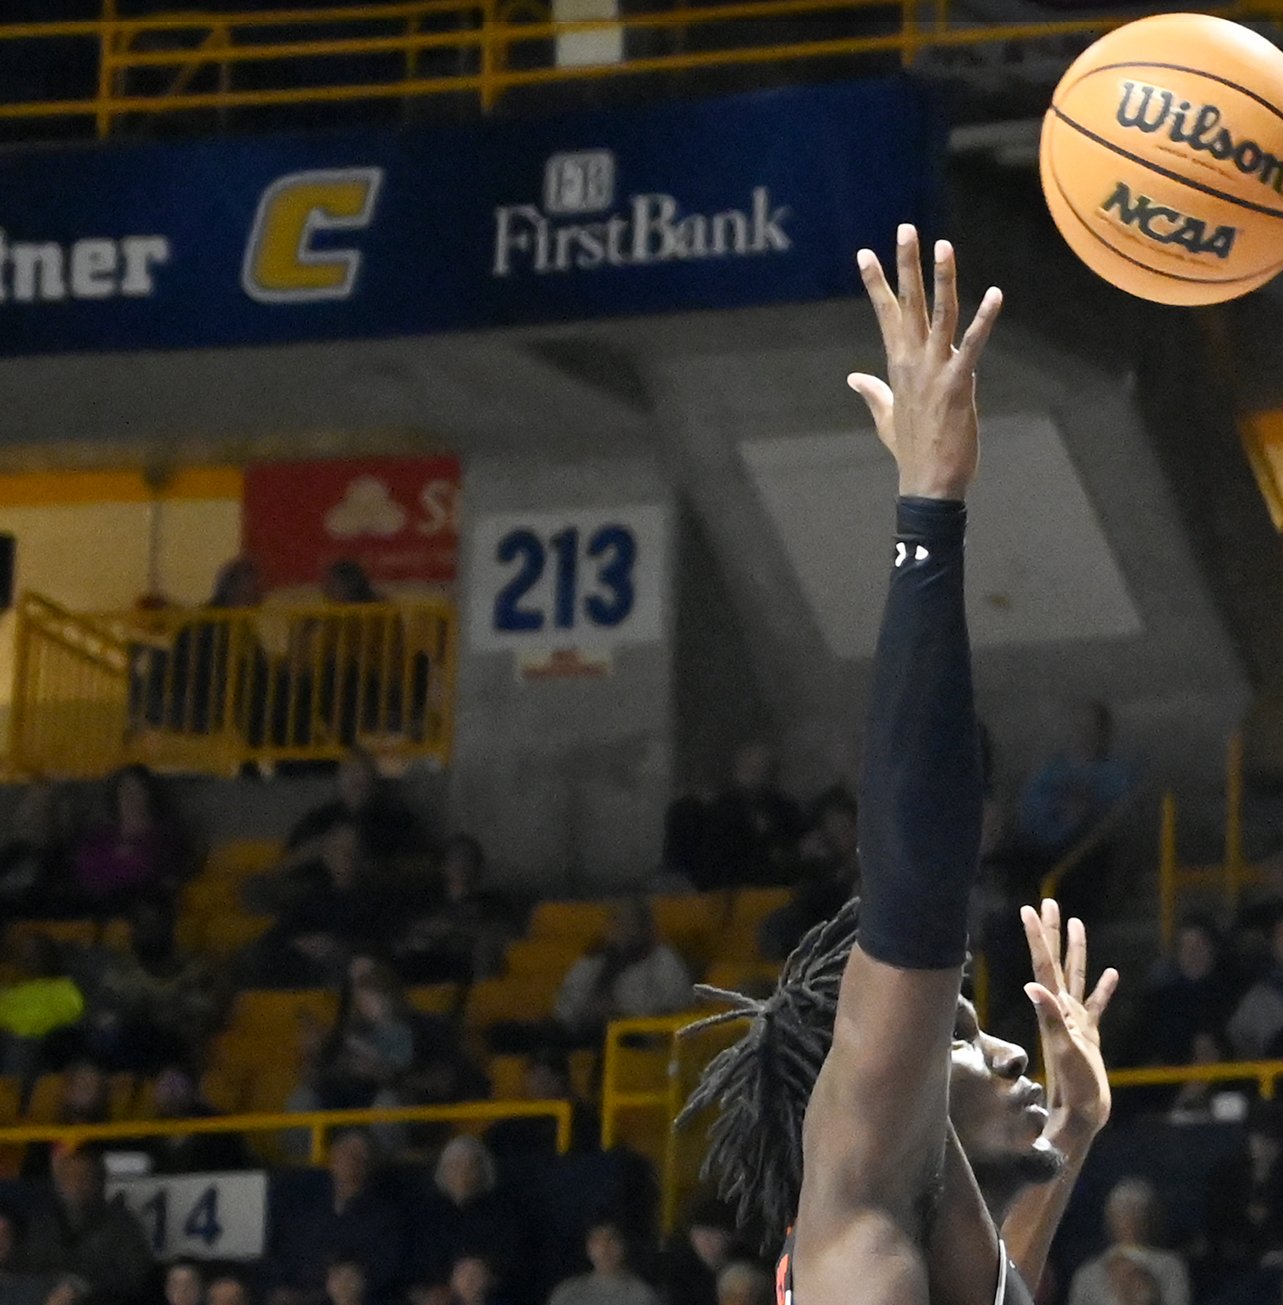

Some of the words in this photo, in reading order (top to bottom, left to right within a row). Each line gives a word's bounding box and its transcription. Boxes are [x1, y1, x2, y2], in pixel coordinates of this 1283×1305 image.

[240, 167, 383, 304] C
[492, 185, 792, 277] FirstBank
[1102, 182, 1237, 259] NCAA
[493, 524, 637, 633] 213
